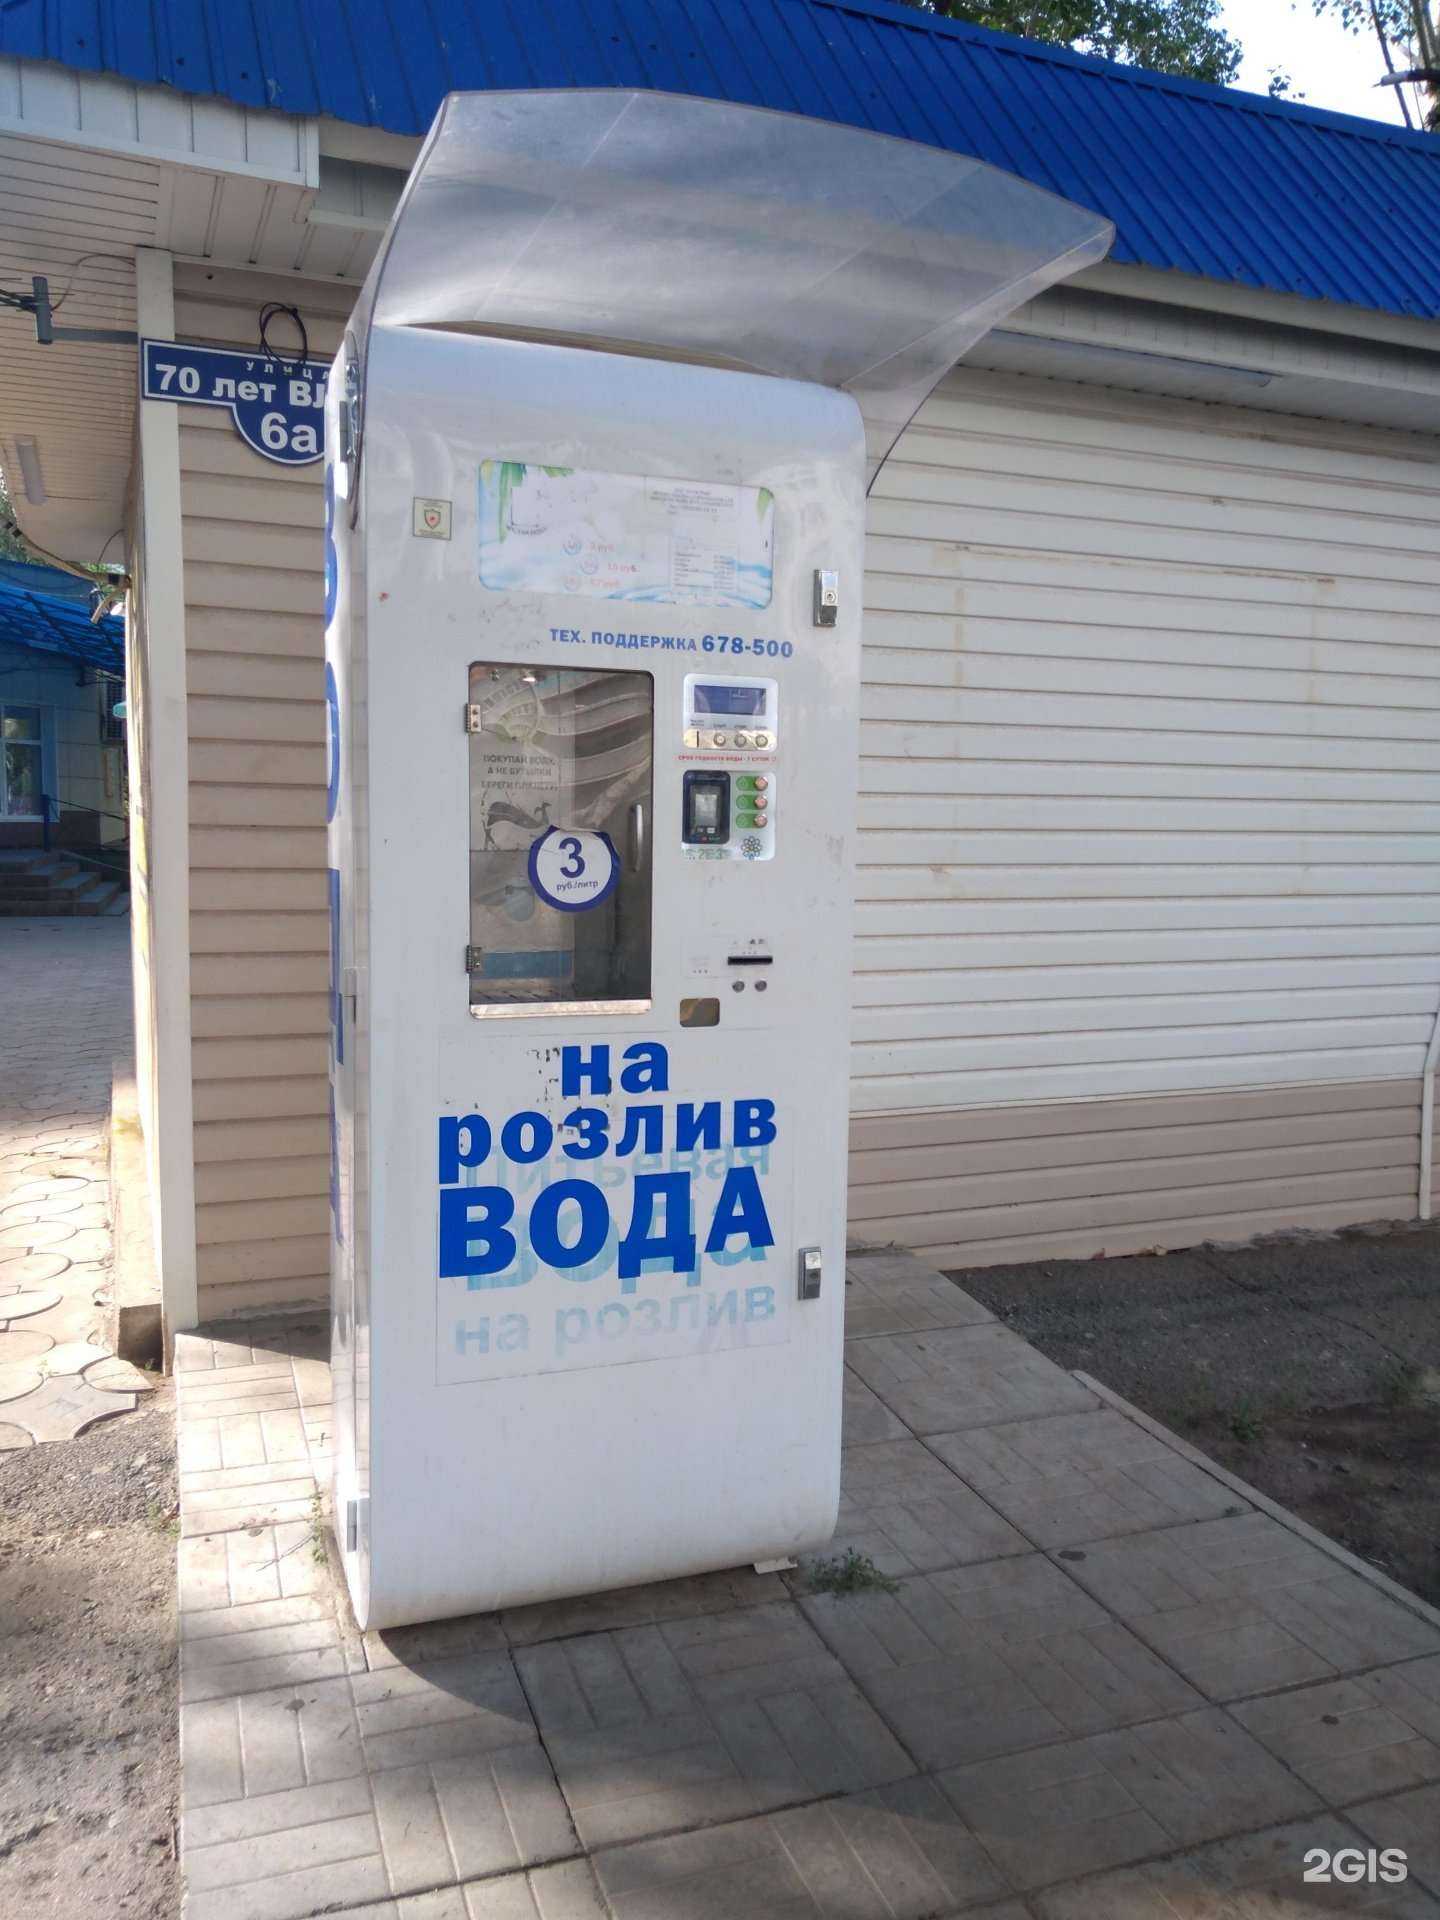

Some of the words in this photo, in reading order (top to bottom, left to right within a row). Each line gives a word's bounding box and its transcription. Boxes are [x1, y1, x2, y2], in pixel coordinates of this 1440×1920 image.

[155, 363, 200, 394] 70
[212, 377, 276, 403] лет
[260, 411, 318, 454] 6а
[550, 628, 586, 644] ТЕХ.
[591, 631, 698, 652] ПОДДЕРЖКА
[702, 635, 793, 658] 678-500
[559, 837, 585, 878] 3
[561, 1041, 669, 1097] на
[438, 1098, 777, 1184] розлив
[438, 1165, 775, 1279] ВОДА
[454, 1312, 530, 1355] на
[555, 1286, 776, 1358] розлив
